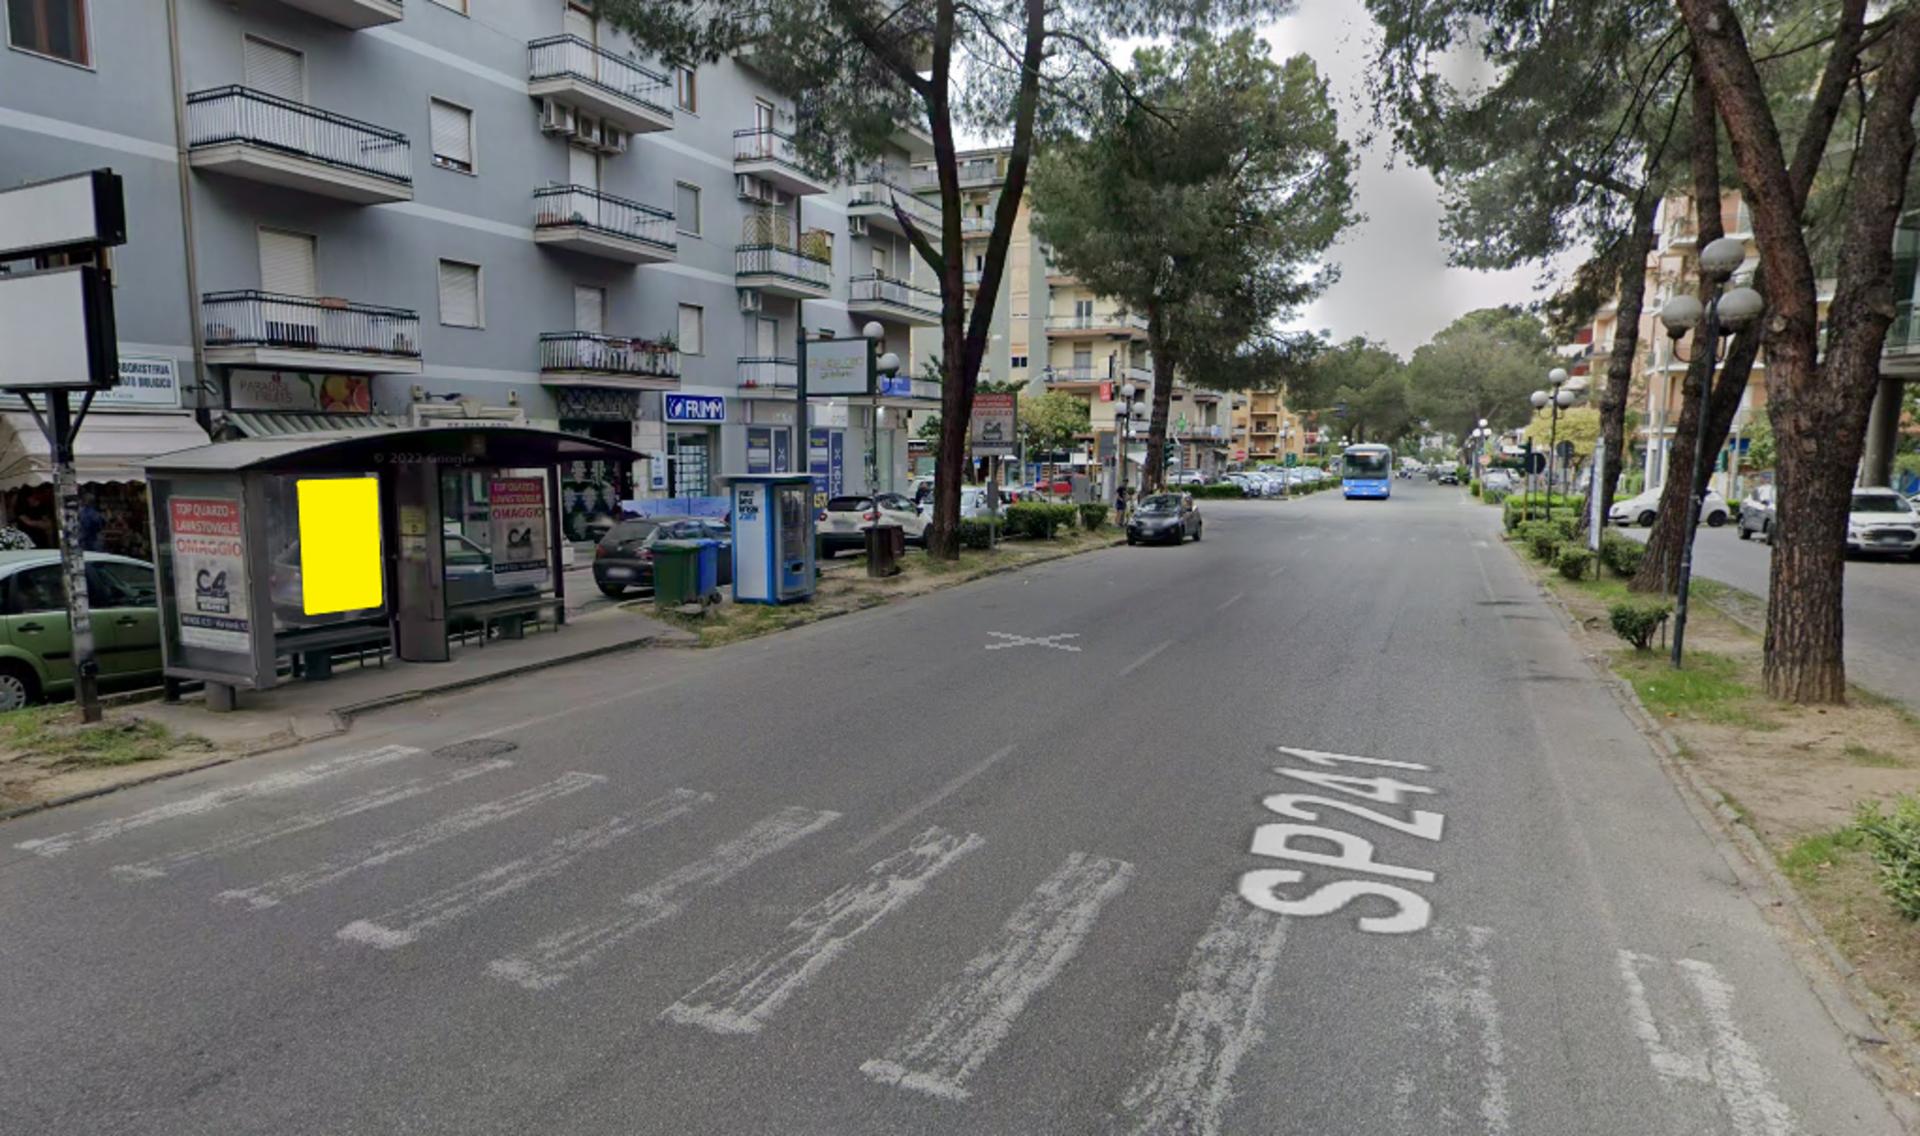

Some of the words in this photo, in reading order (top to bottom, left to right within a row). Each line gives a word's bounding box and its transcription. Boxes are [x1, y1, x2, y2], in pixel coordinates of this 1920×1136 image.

[176, 503, 192, 514] TOP
[193, 503, 229, 517] QUARZO
[492, 506, 544, 520] OMAGGIO
[176, 538, 243, 557] OMAGGIO
[197, 569, 227, 595] C4
[1239, 746, 1446, 934] SP241
